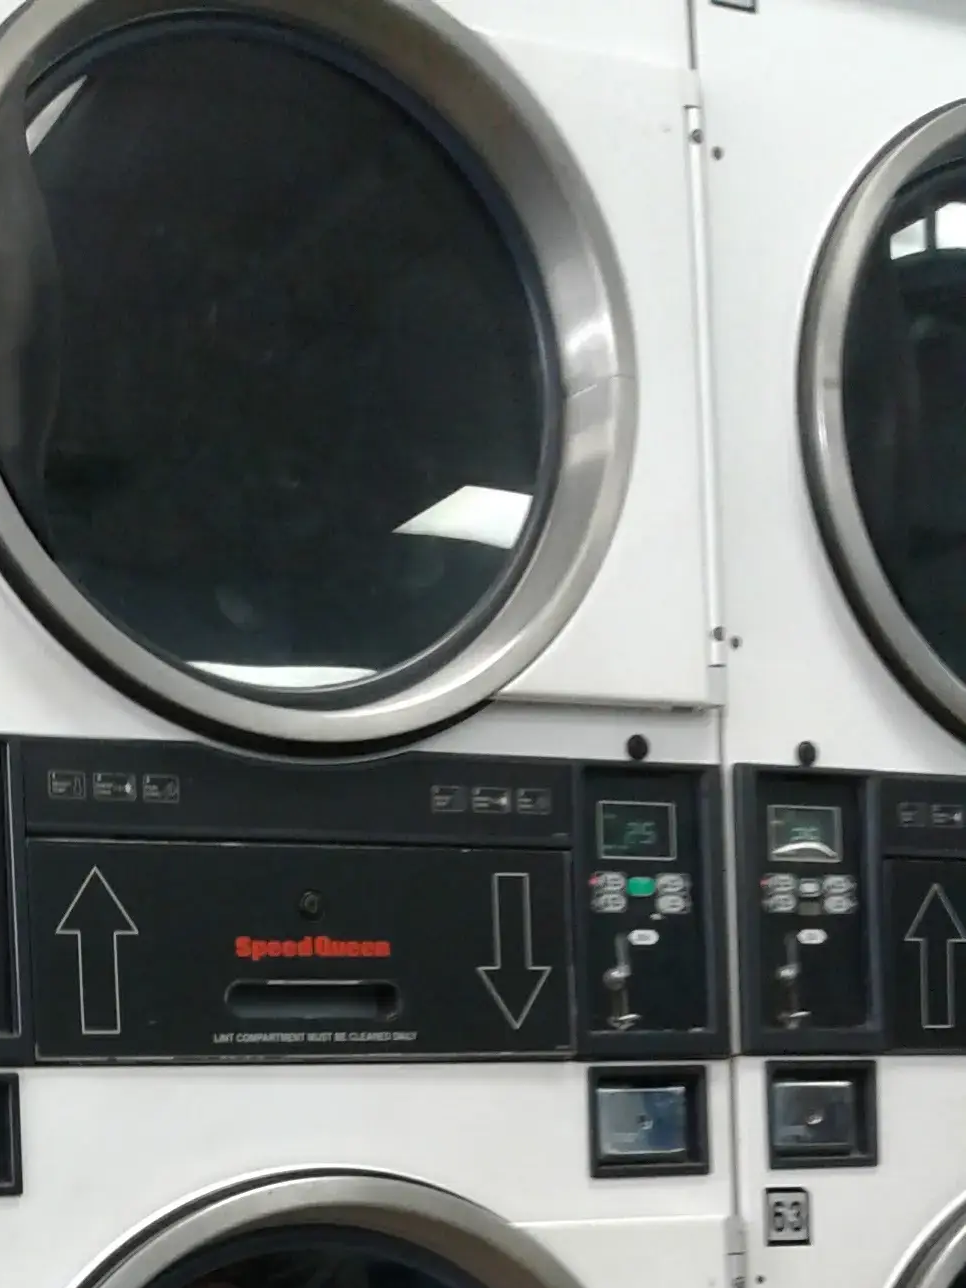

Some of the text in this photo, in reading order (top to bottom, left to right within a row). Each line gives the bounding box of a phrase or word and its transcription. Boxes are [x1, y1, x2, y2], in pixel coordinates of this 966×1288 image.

[236, 936, 391, 961] Speed Queen
[213, 1032, 234, 1044] LINT
[236, 1032, 305, 1043] COMPARTMENT
[307, 1032, 332, 1042] MUST
[334, 1032, 347, 1042] BE
[349, 1031, 392, 1042] CLEANED
